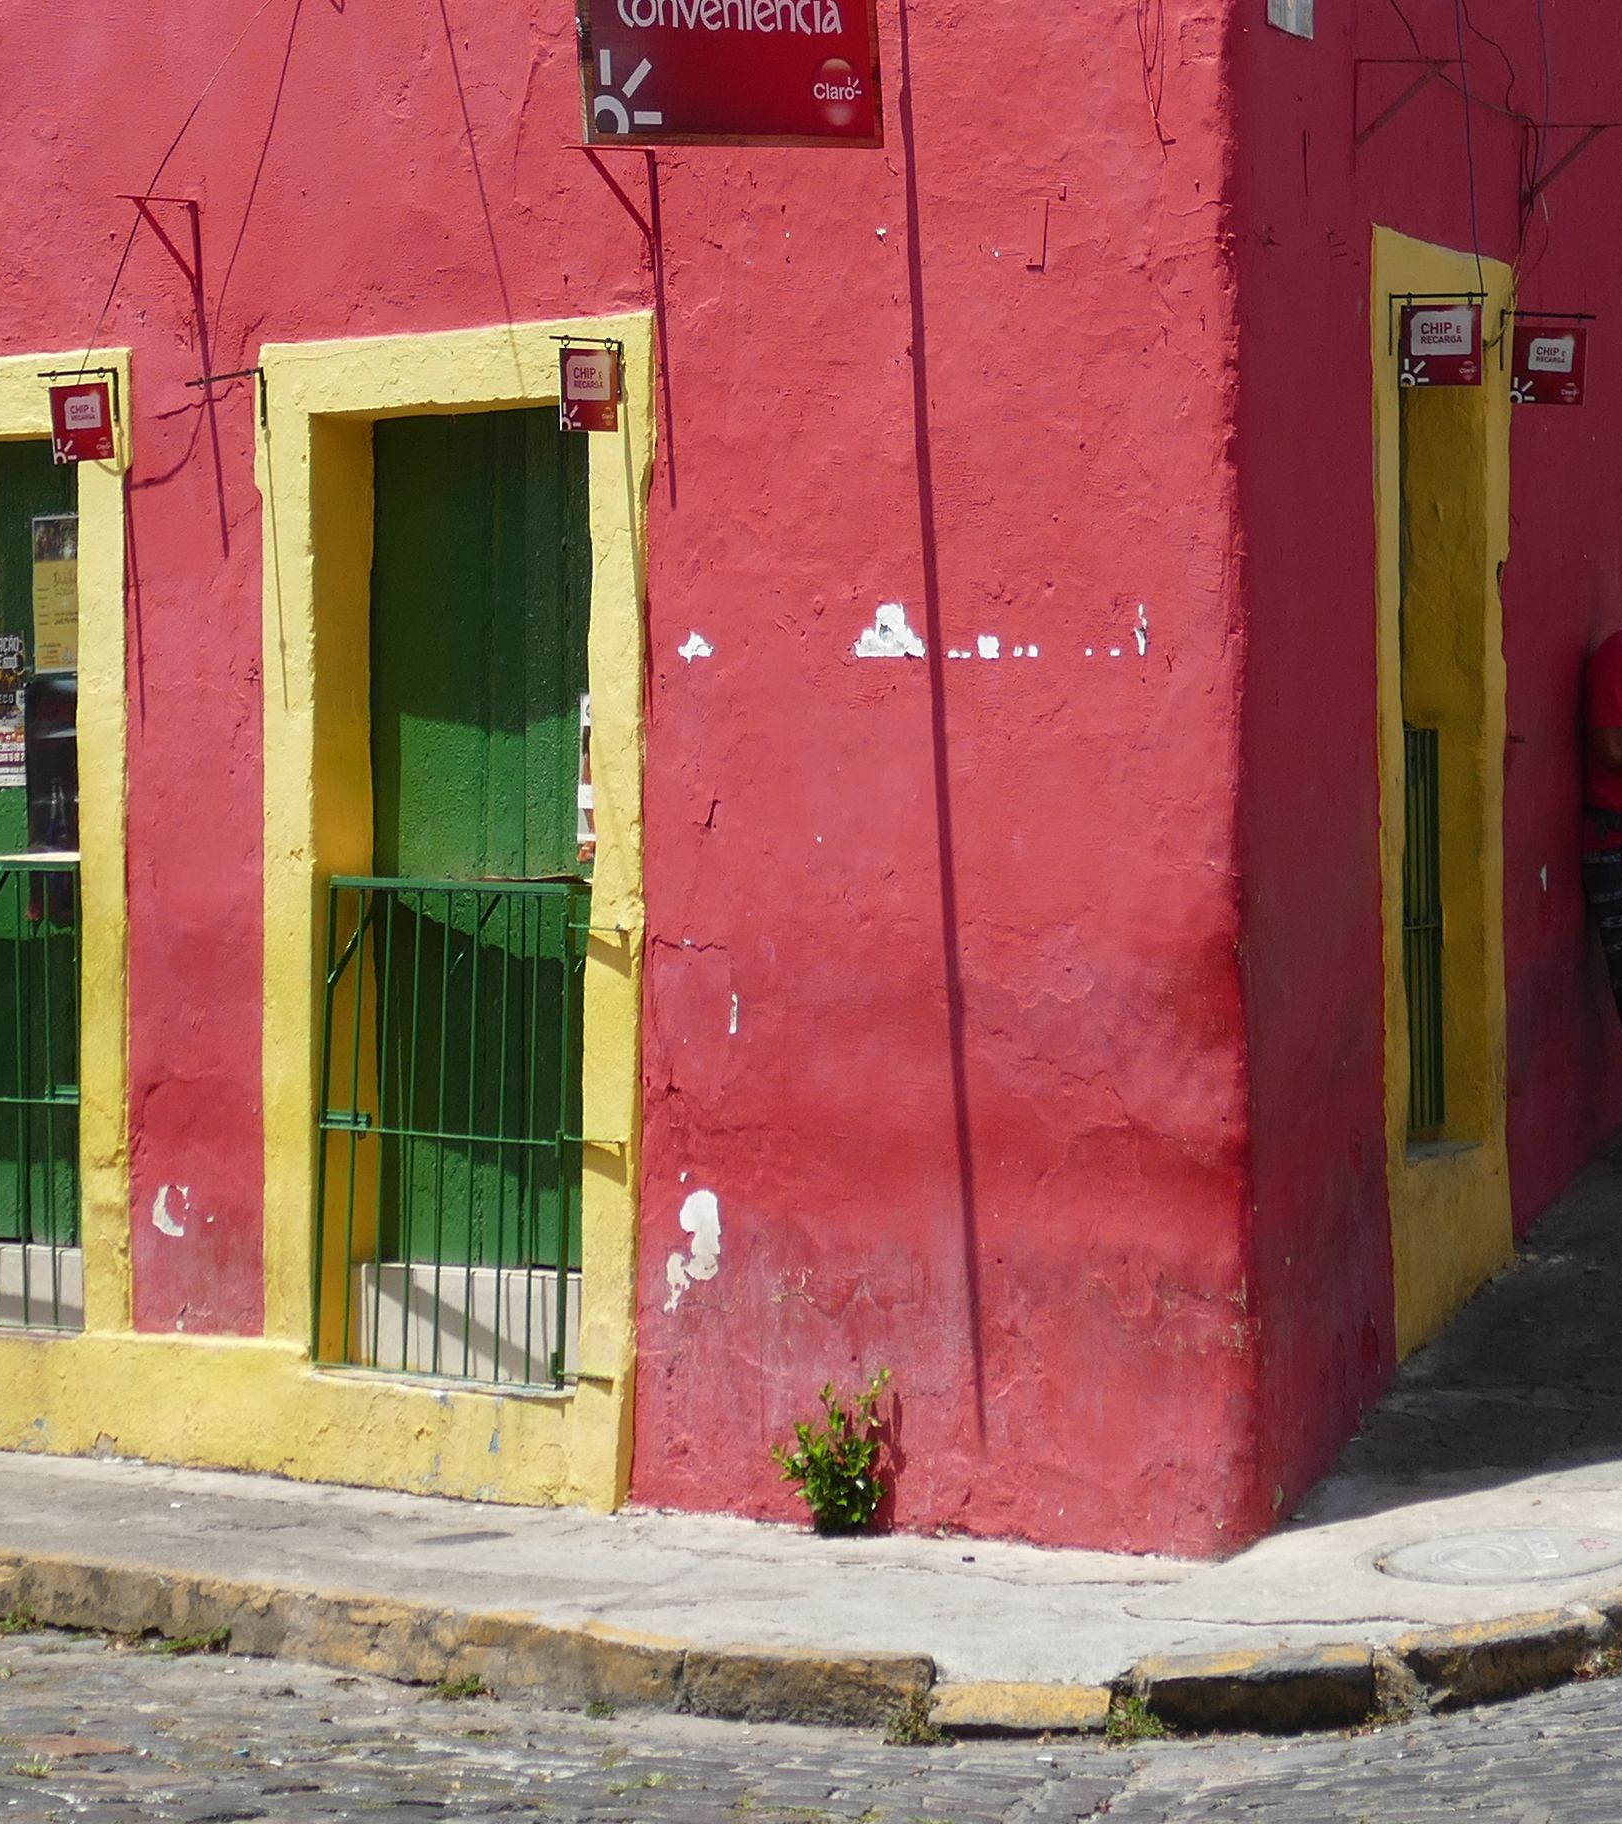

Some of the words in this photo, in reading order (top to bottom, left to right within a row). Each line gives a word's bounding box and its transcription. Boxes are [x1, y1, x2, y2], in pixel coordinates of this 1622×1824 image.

[813, 80, 859, 101] Claro
[1420, 322, 1452, 335] CHIP
[1456, 325, 1462, 334] E
[1420, 334, 1463, 345] RECARGA
[1536, 345, 1561, 357] CHIP
[574, 367, 596, 379] CHIP
[574, 380, 603, 389] RECARGA
[70, 405, 89, 414] CHIP
